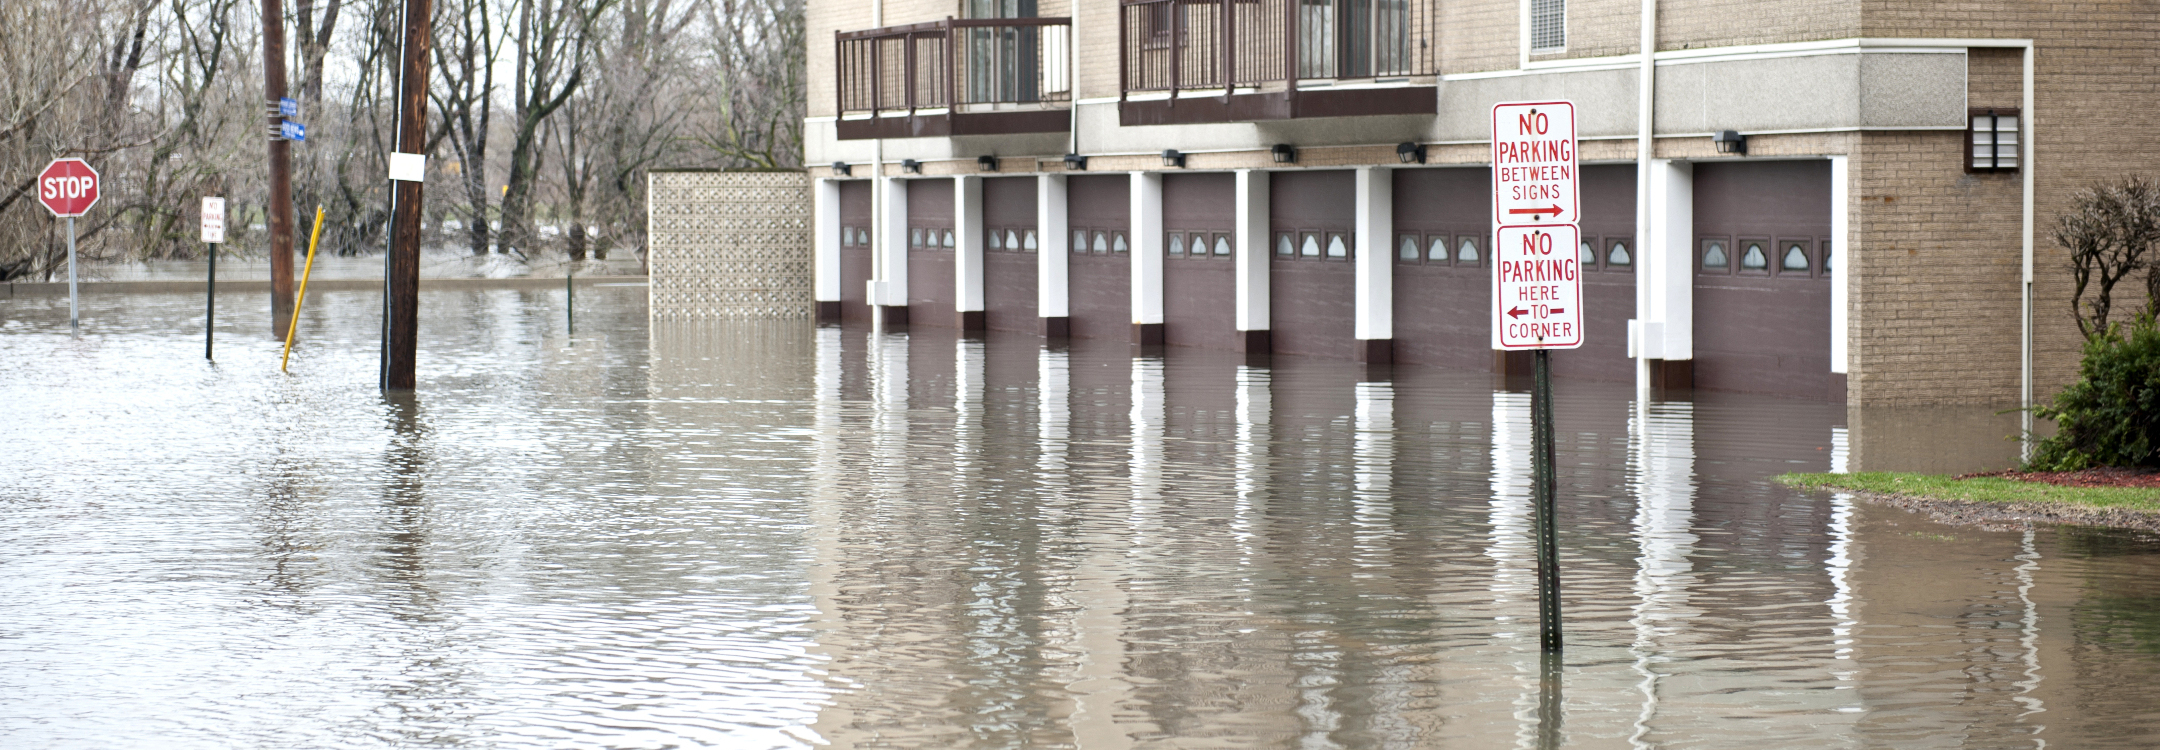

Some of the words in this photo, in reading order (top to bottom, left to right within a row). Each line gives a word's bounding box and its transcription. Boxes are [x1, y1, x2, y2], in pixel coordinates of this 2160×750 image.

[1520, 113, 1548, 135] NO
[1500, 140, 1571, 163] PARKING
[1502, 165, 1570, 182] BETWEEN
[44, 176, 94, 200] STOP
[1512, 184, 1560, 200] SIGNS
[209, 202, 217, 210] NO
[1523, 233, 1552, 255] NO
[1502, 259, 1574, 282] PARKING
[1519, 286, 1559, 301] HERE
[1531, 304, 1549, 319] TO
[1509, 322, 1572, 338] CORNER
